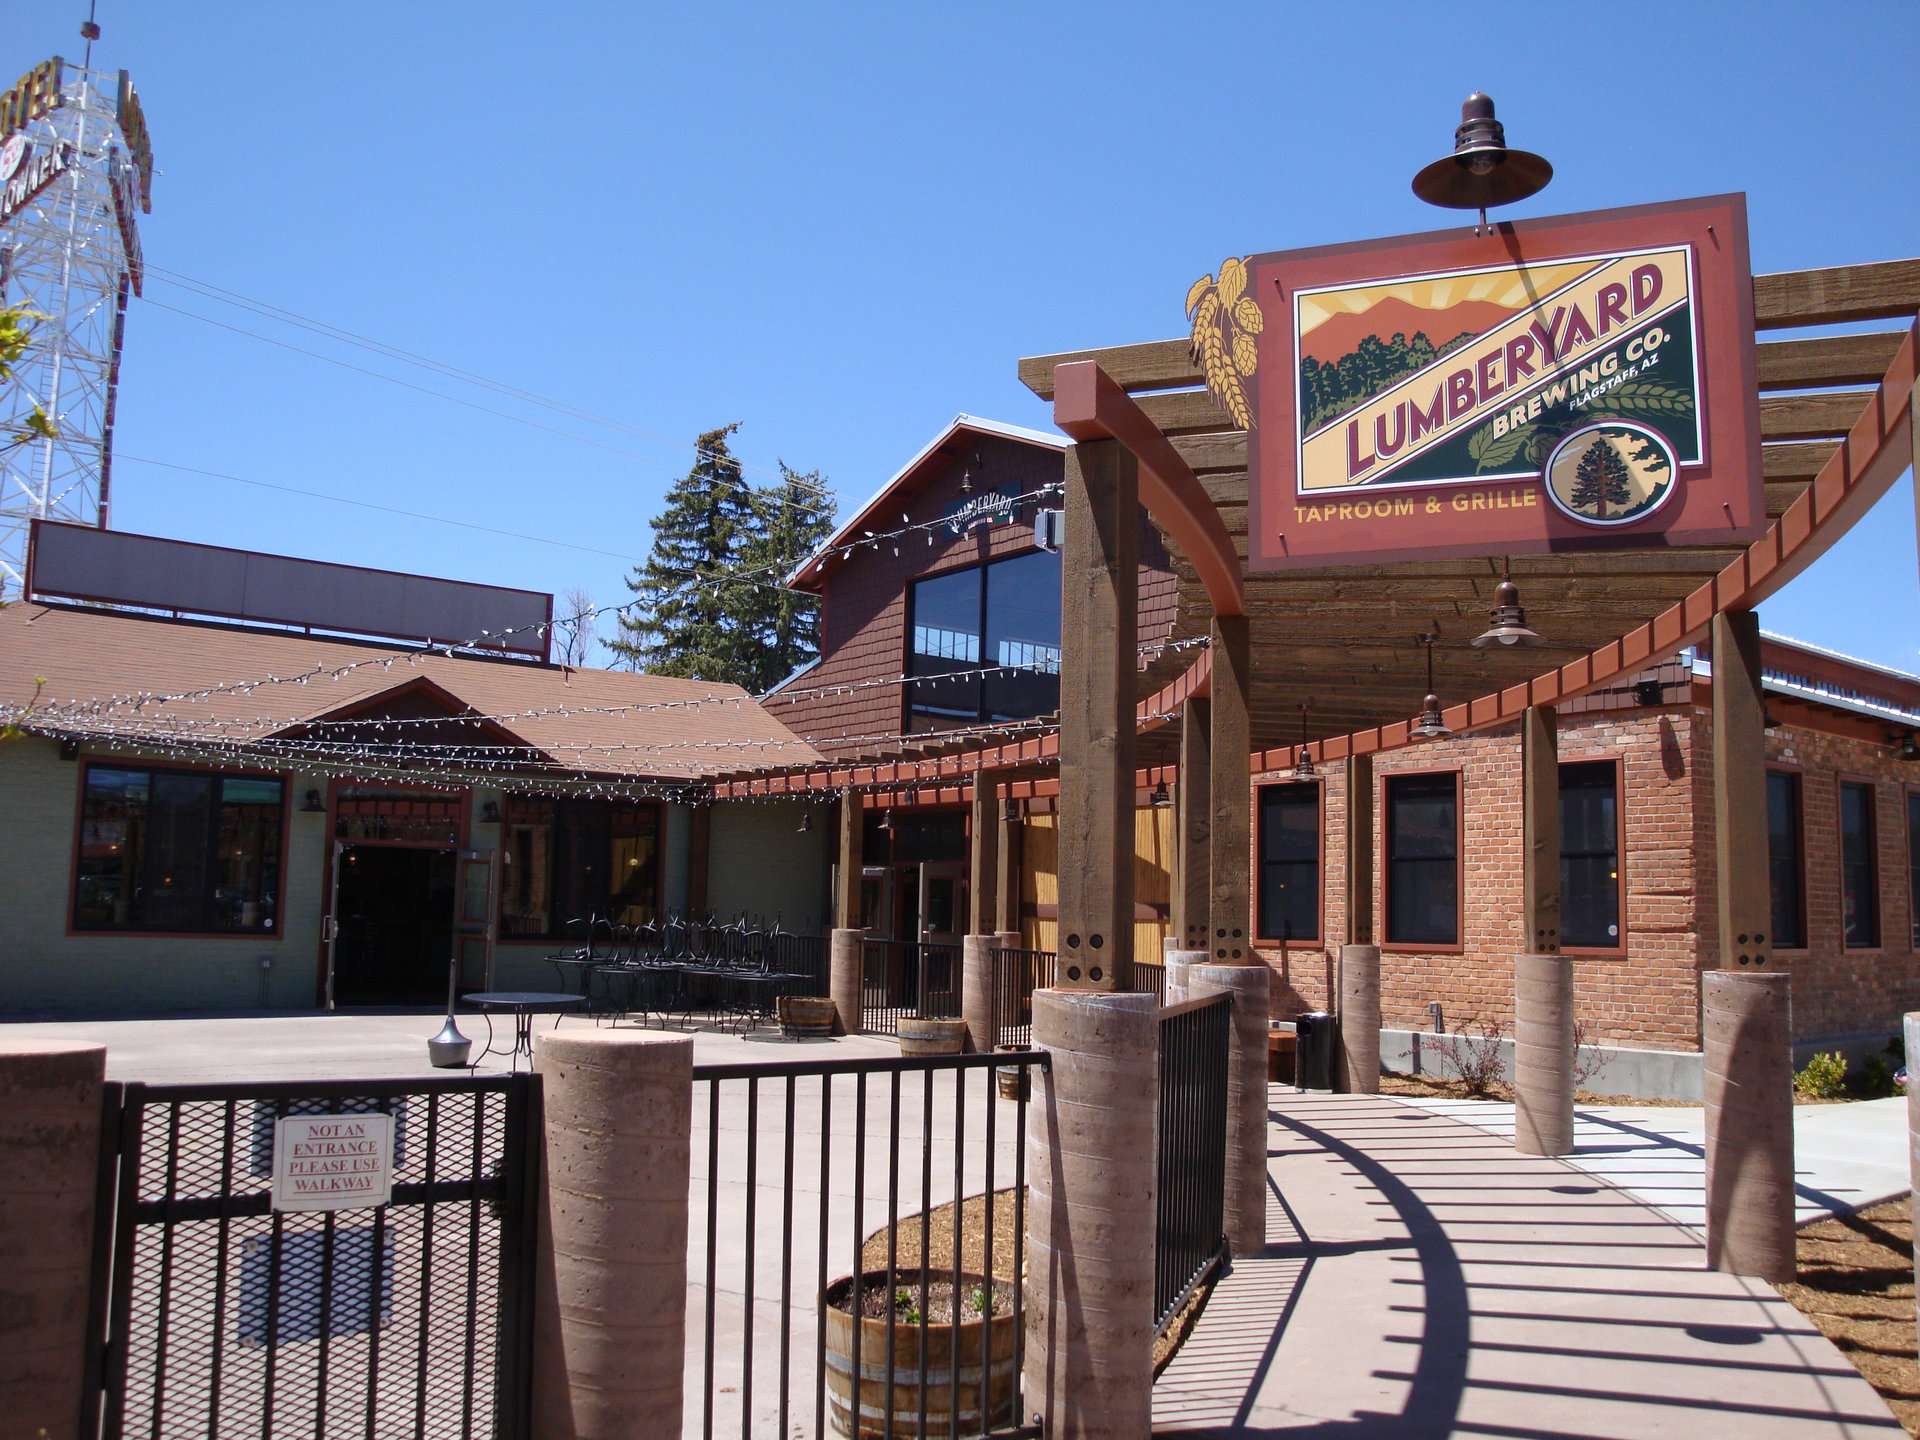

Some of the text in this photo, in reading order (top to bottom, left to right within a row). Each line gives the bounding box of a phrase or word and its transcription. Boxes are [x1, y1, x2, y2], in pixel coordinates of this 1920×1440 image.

[1346, 263, 1664, 482] LUMBERYARD
[1492, 327, 1672, 440] BREWING CO.
[1568, 352, 1660, 412] FLAGSTAFF, AZ
[1293, 488, 1537, 524] TAPROOM & GRILLE
[308, 1123, 366, 1138] NOT AN
[293, 1140, 378, 1156] ENTRANCE
[289, 1157, 380, 1174] PLEASE USE
[295, 1175, 374, 1191] WALKWAY
